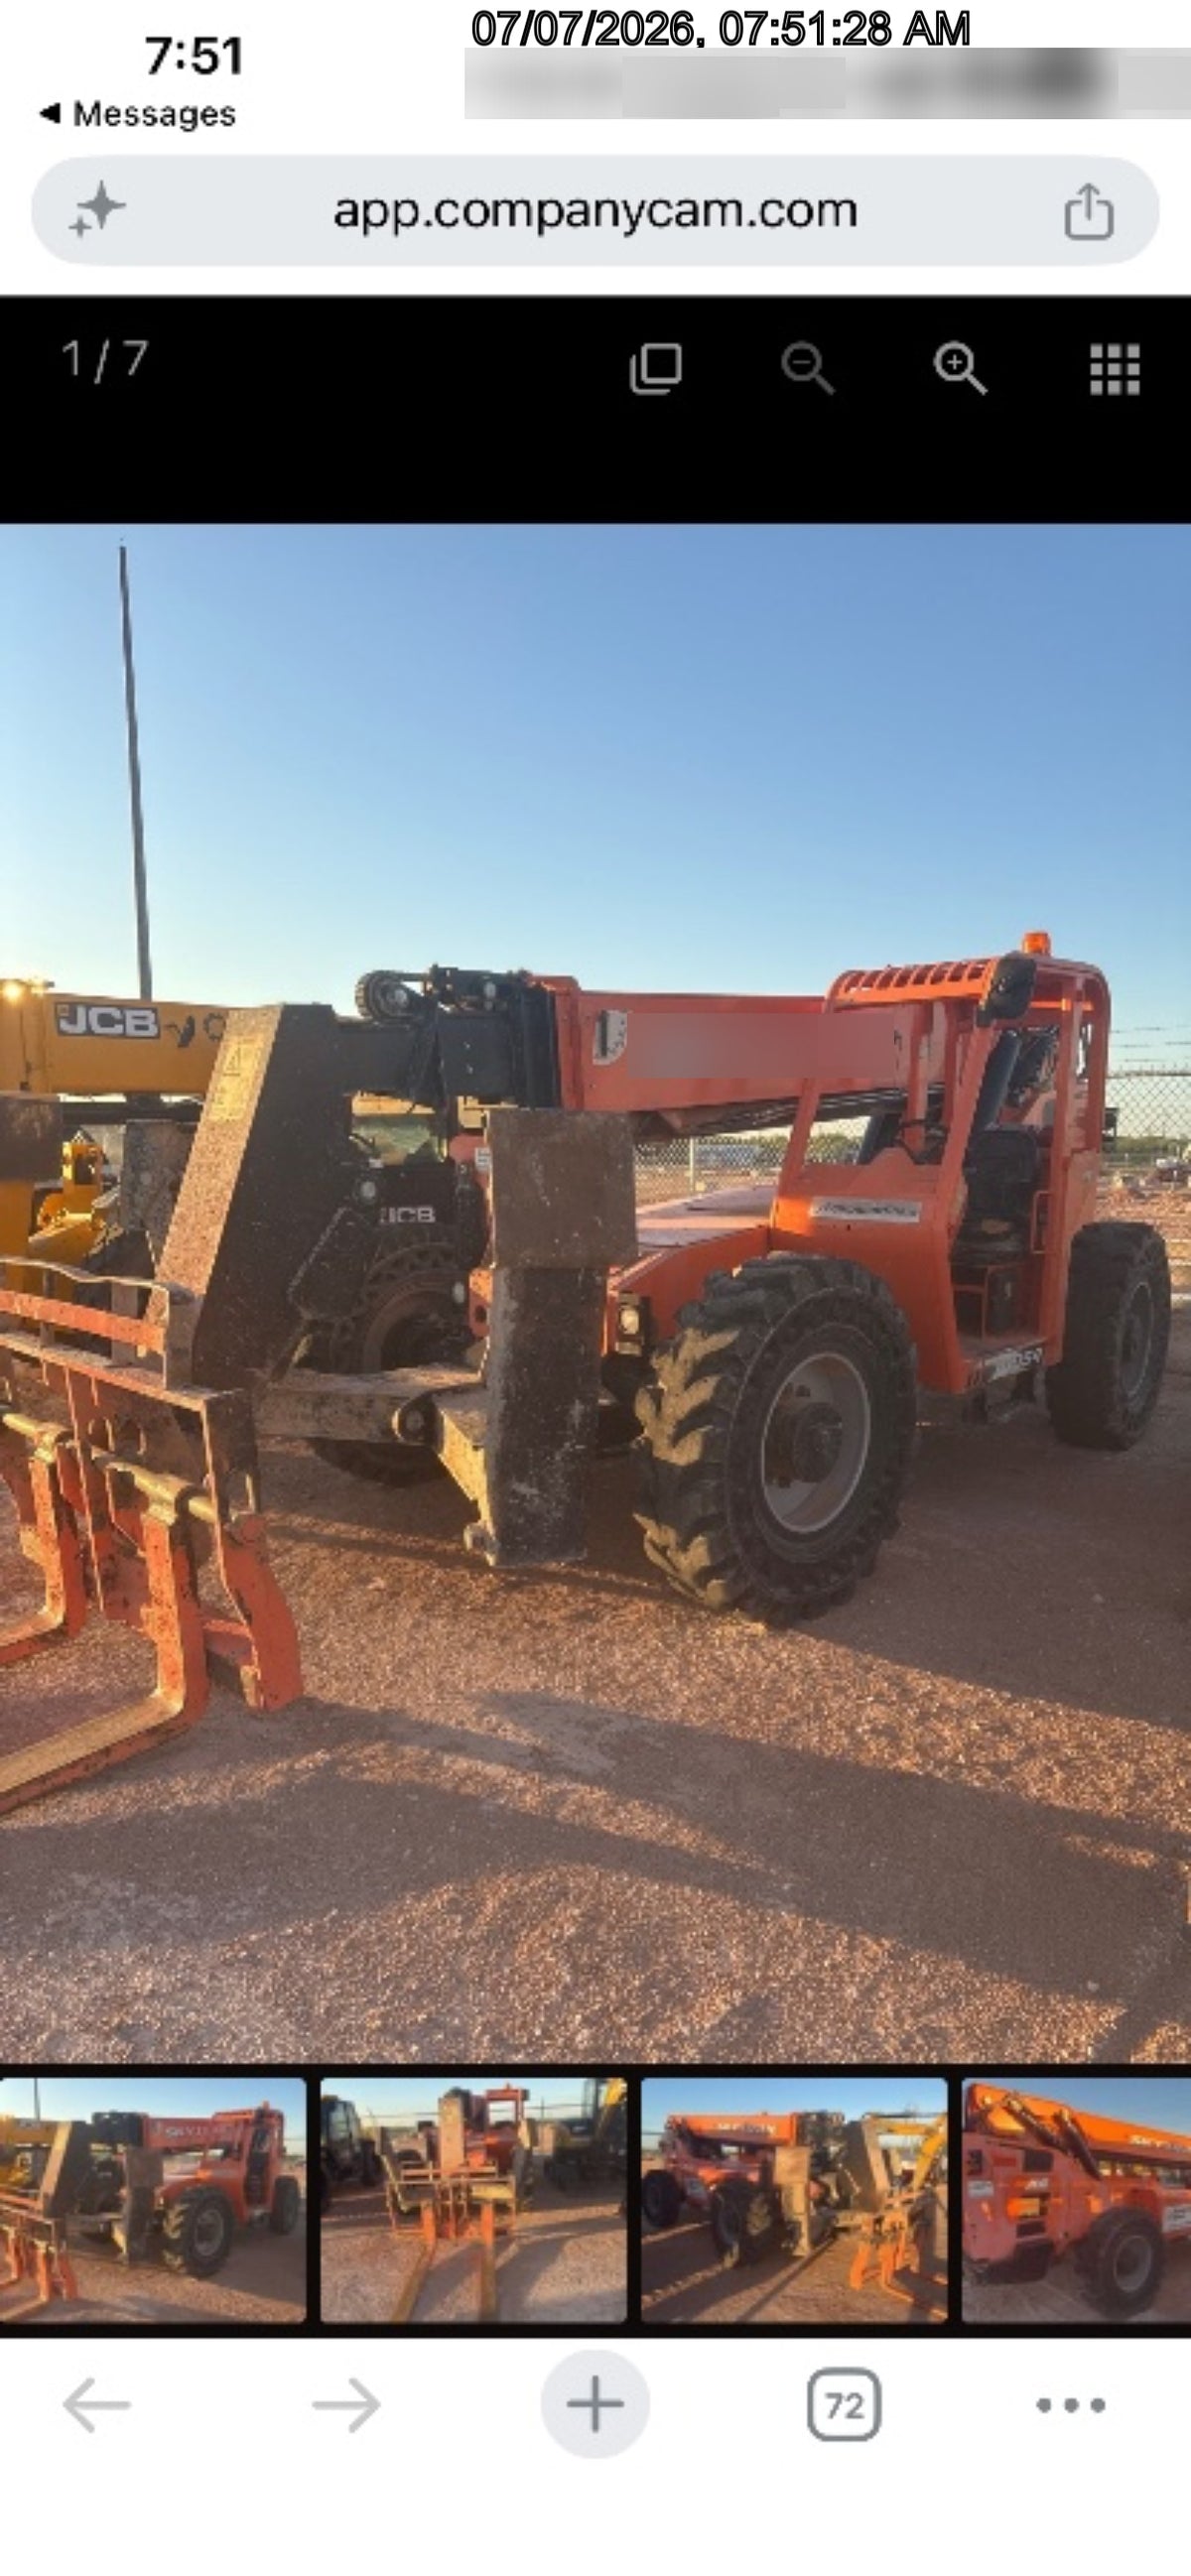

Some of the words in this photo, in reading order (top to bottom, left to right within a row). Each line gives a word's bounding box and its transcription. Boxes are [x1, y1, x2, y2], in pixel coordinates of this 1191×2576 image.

[145, 36, 241, 75] 7:51
[73, 100, 237, 133] Messages
[332, 196, 858, 238] app.companycam.com
[58, 1004, 159, 1038] JCB
[825, 2391, 864, 2419] 72
